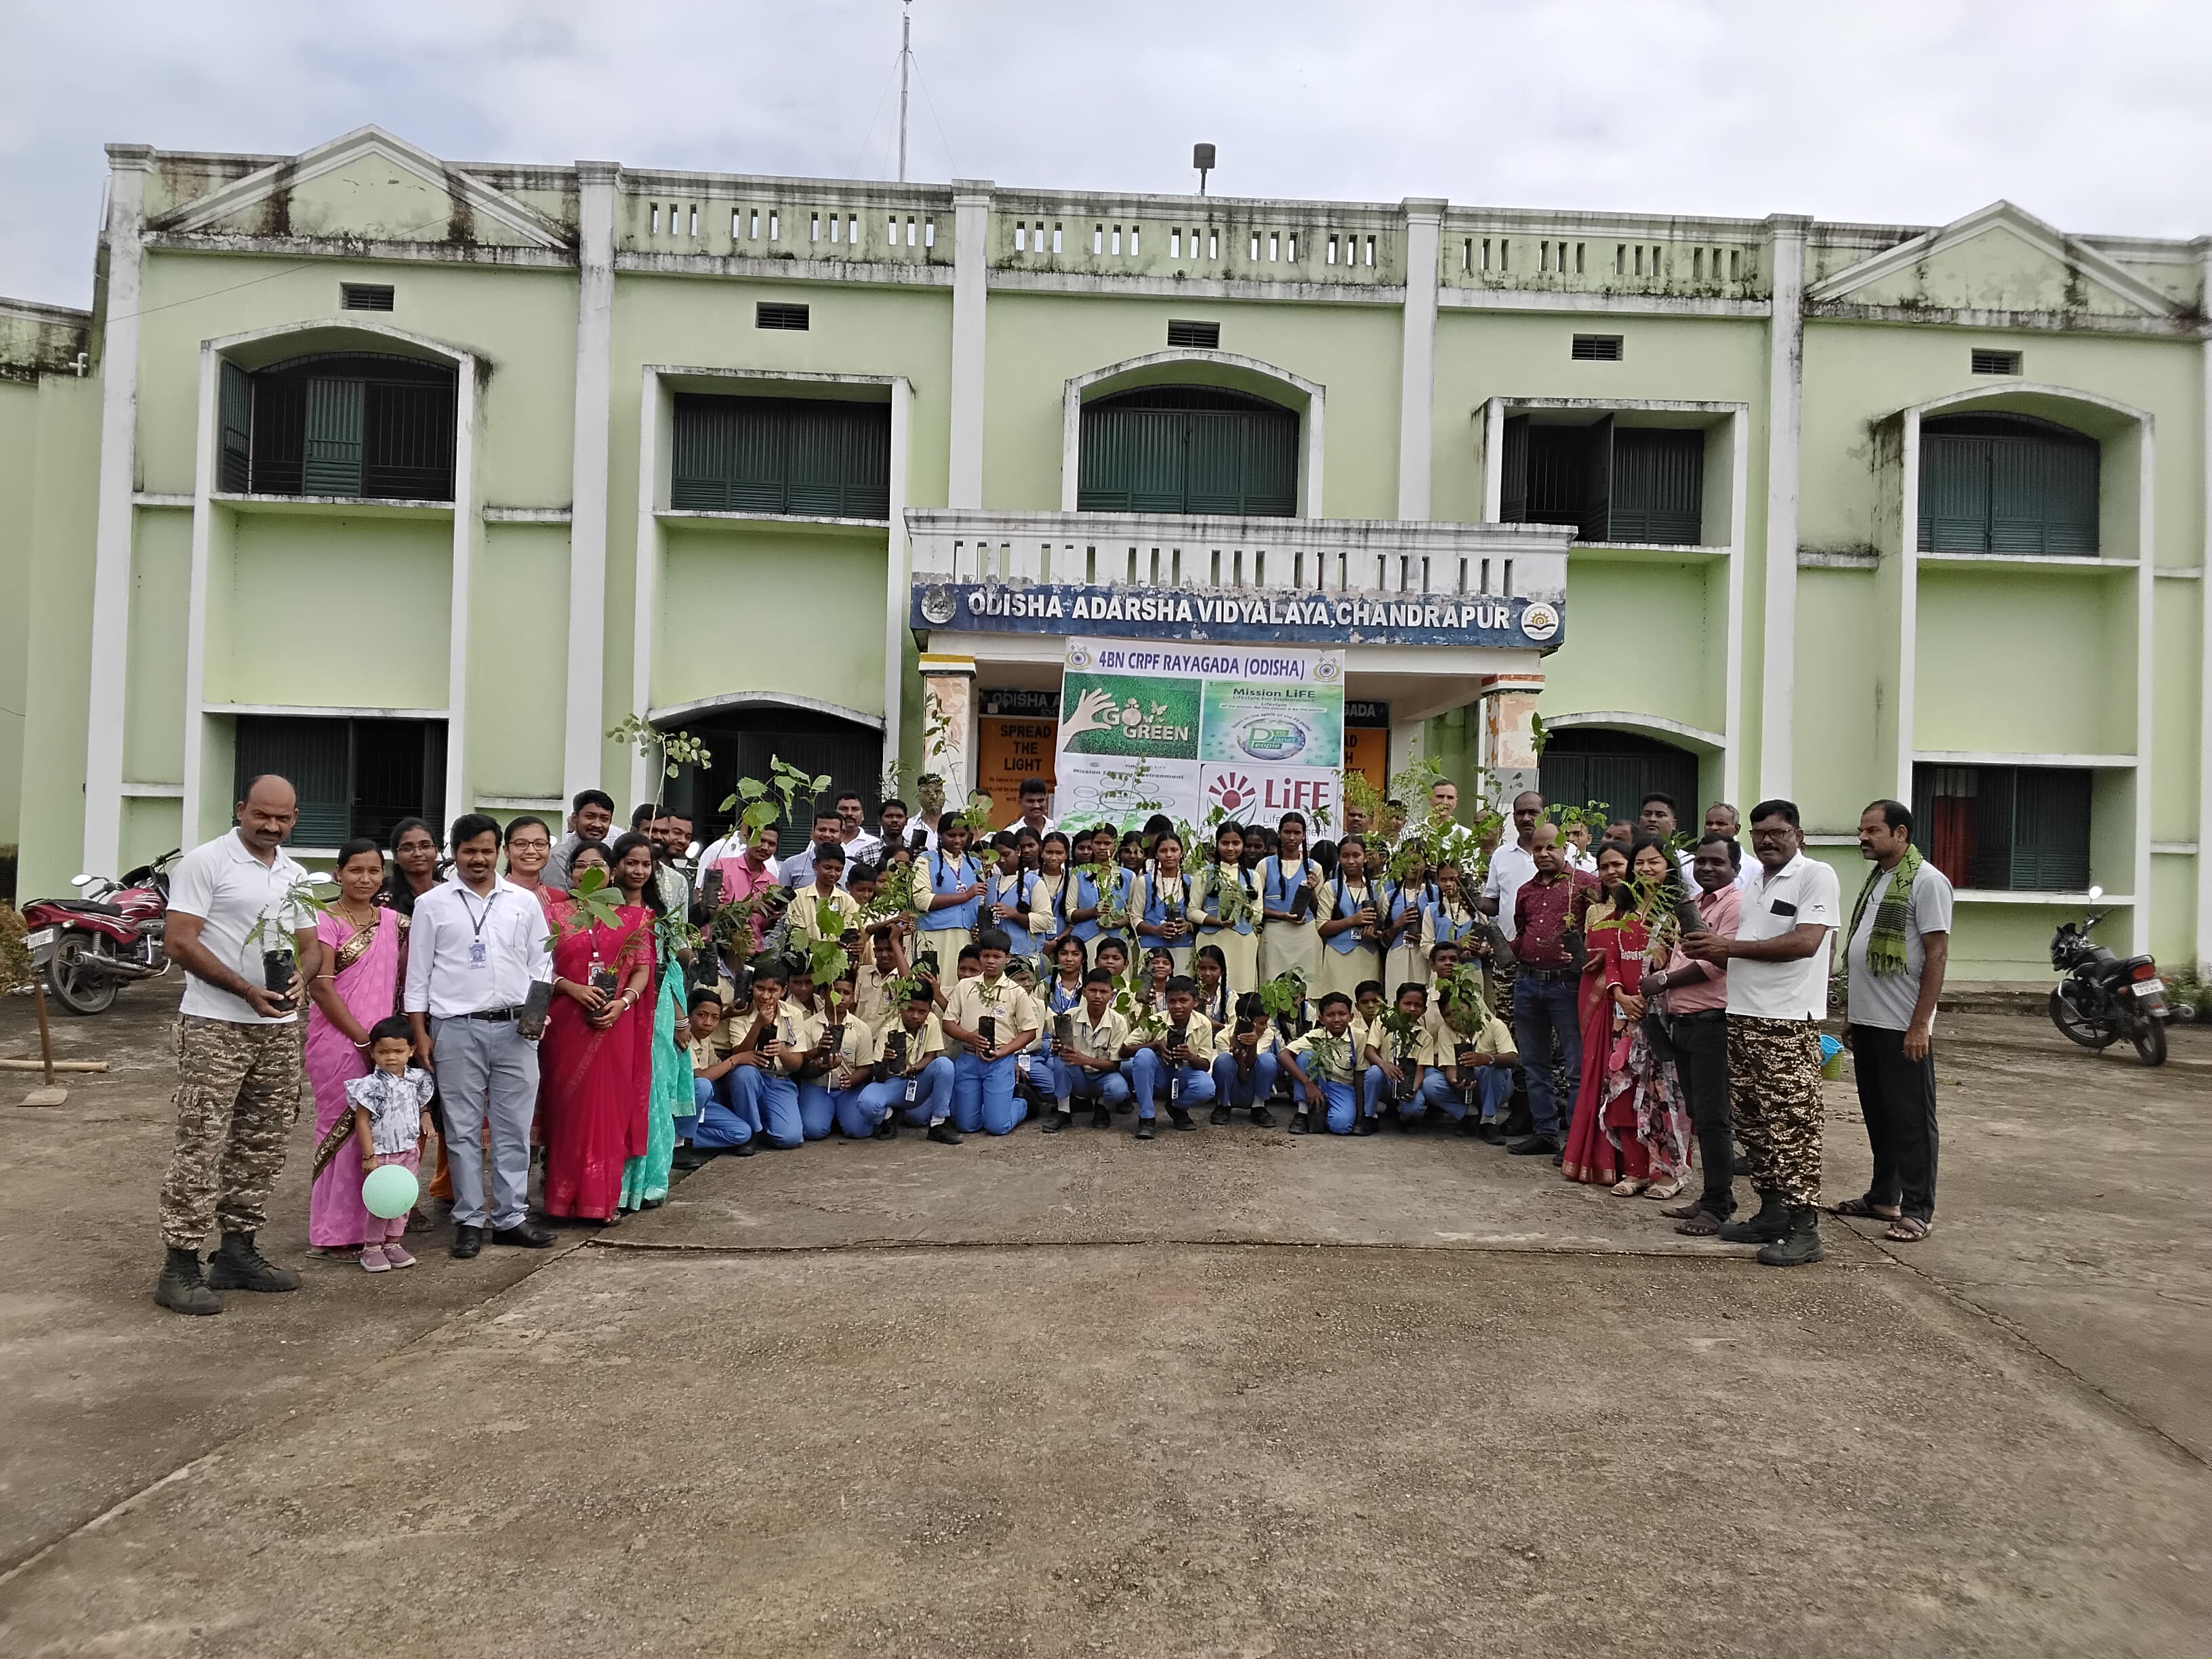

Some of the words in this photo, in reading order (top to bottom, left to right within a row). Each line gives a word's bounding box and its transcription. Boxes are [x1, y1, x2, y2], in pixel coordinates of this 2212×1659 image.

[968, 592, 1063, 618] ODISHA
[1071, 596, 1193, 622] ADARSHA
[1099, 651, 1125, 668] 4BN
[1128, 653, 1160, 670] CRPF
[1164, 655, 1239, 674] RAYAGADA
[1244, 657, 1305, 680] (ODISHA)
[991, 692, 1048, 708] ODISHA
[1233, 688, 1281, 697] Mission
[1286, 689, 1316, 698] LiFE
[1000, 724, 1051, 738] SPREAD
[1123, 724, 1189, 741] GREEN
[1014, 741, 1038, 754] THE
[1004, 758, 1042, 771] LIGHT
[1265, 777, 1330, 810] LiFE
